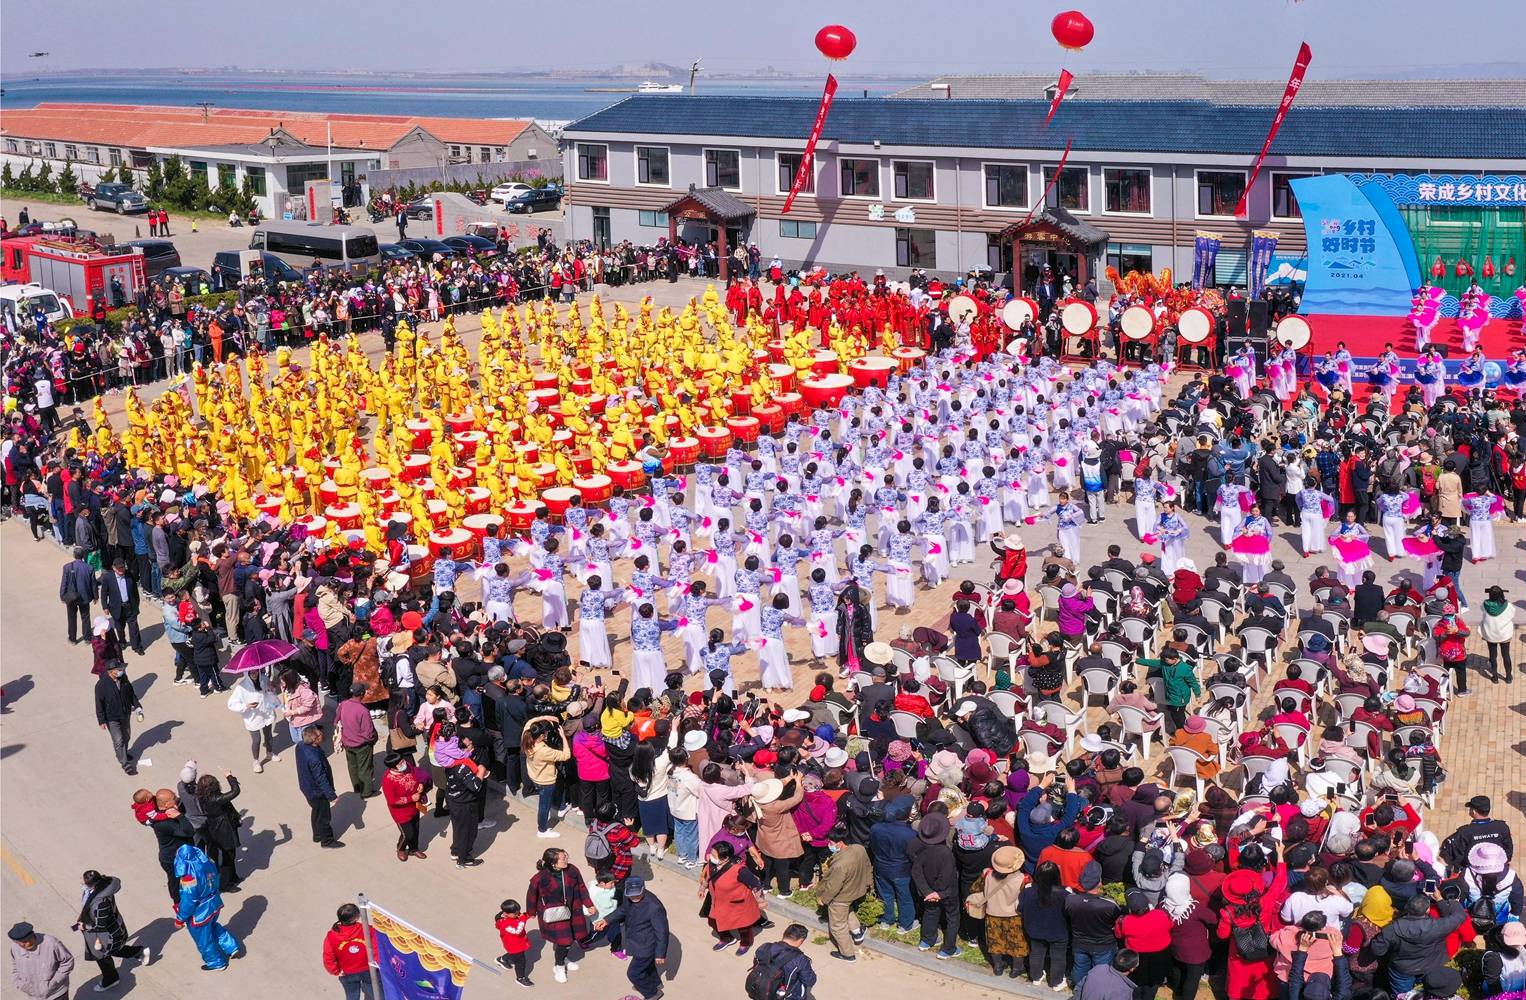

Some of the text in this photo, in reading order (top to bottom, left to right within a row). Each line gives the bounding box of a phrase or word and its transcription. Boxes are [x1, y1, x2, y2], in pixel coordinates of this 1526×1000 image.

[1342, 219, 1376, 236] 乡村
[1321, 236, 1376, 254] 好时节
